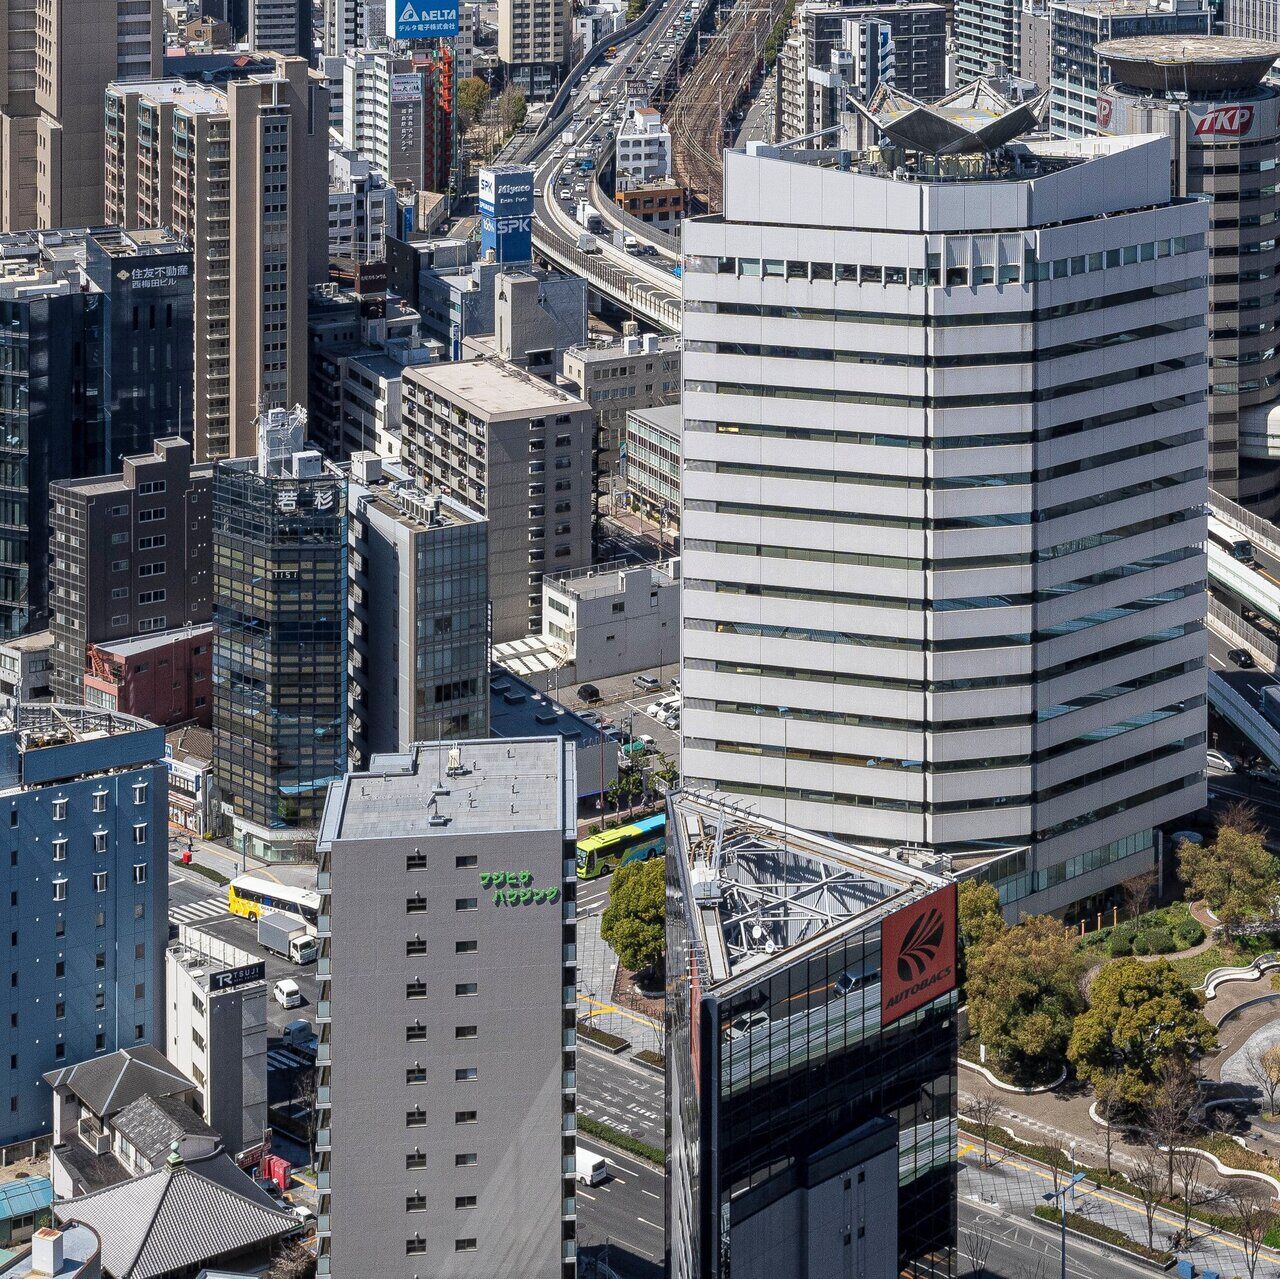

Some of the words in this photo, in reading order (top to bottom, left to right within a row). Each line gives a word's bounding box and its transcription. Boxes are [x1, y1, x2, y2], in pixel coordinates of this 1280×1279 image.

[421, 9, 457, 21] DELTA
[1202, 108, 1251, 132] TKP
[497, 218, 531, 235] SPK
[131, 264, 190, 280] 住友不動産
[131, 277, 177, 289] 西梅田ビル
[480, 870, 532, 887] フジヒサ
[493, 886, 560, 905] ハウジング
[233, 966, 260, 979] TSUJI
[885, 965, 952, 1009] AUTOBACS
